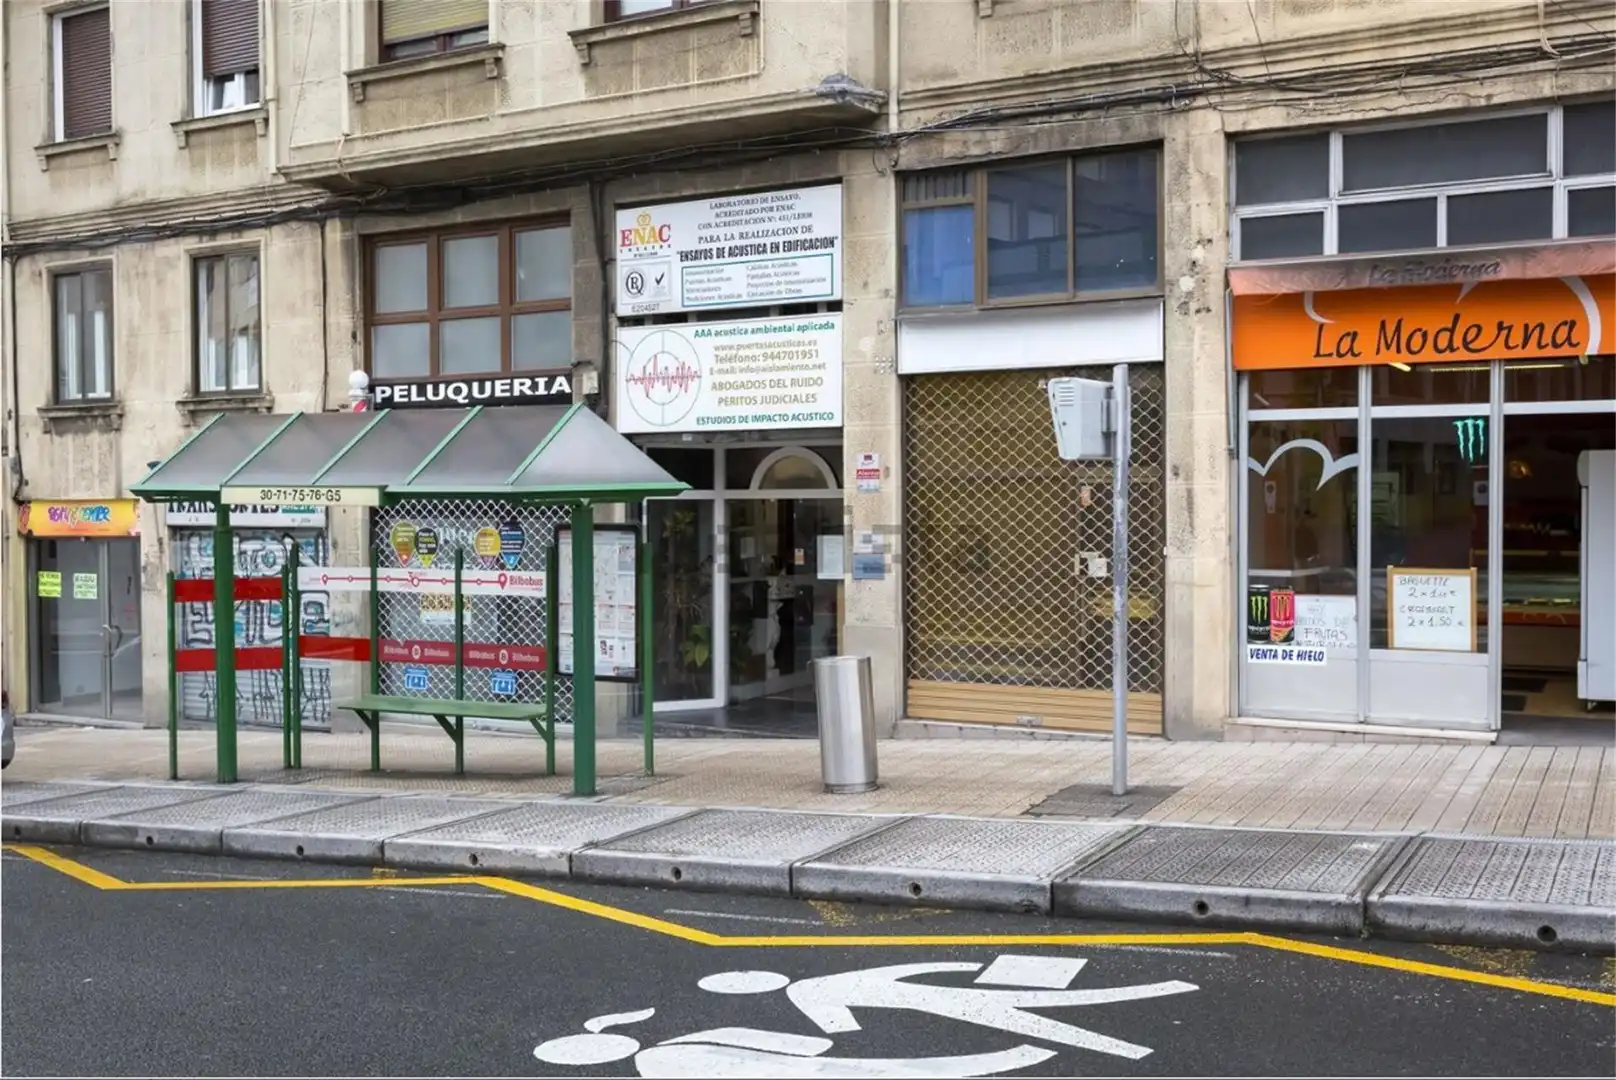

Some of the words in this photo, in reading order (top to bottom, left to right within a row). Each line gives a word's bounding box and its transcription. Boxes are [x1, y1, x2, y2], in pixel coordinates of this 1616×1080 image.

[710, 197, 758, 210] LABORATORIO
[759, 196, 769, 205] DE
[714, 207, 759, 218] ACREDITADO
[760, 205, 775, 214] POR
[776, 203, 796, 212] ENAC
[698, 222, 713, 230] CON
[714, 217, 766, 229] ACREDITACION
[620, 224, 671, 247] ENAC
[698, 235, 721, 245] PARA
[724, 233, 735, 241] LA
[738, 226, 799, 240] REALIZACION
[800, 224, 814, 234] DE
[716, 246, 725, 259] DE
[728, 242, 768, 258] ACUSTICA
[769, 241, 780, 254] EN
[694, 329, 712, 338] AAA
[750, 323, 795, 335] ambiental
[796, 321, 835, 333] aplicada
[1313, 323, 1361, 359] La
[1375, 313, 1581, 357] Moderna
[714, 351, 761, 365] Teléfono:
[762, 349, 819, 362] 944701951
[374, 375, 572, 404] PELUQUERIA
[711, 379, 766, 391] ABOGADOS
[769, 378, 788, 389] DEL
[790, 376, 824, 388] RUIDO
[718, 395, 758, 406] PERITOS
[759, 393, 817, 406] JUDICIALES
[696, 415, 736, 426] ESTUDIOS
[738, 414, 750, 424] DE
[751, 412, 789, 423] IMPACTO
[791, 411, 834, 421] ACUSTICO
[260, 488, 342, 502] 30-71-75-76-G5
[509, 574, 544, 587] Bilbobus
[1408, 587, 1418, 598] 2
[1407, 616, 1416, 627] 2
[1303, 627, 1348, 641] FRUTAS
[1249, 648, 1278, 661] VENTA
[1281, 649, 1294, 660] DE
[1296, 649, 1325, 662] HIELO
